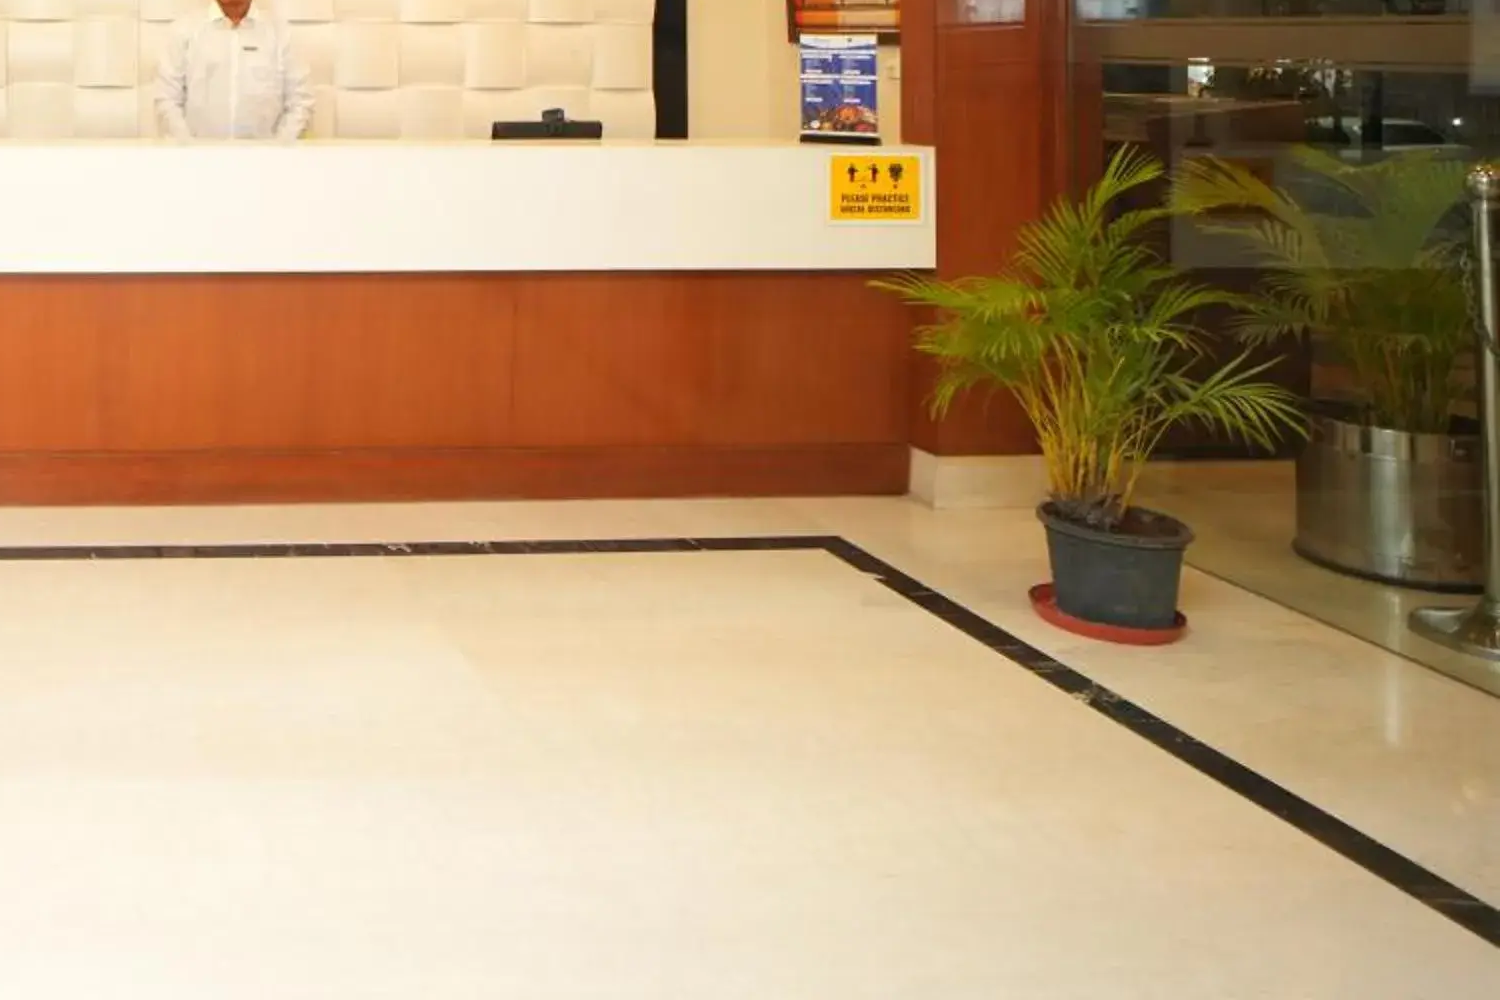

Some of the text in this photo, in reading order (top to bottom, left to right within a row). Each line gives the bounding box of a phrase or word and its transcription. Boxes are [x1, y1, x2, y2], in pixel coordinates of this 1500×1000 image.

[841, 193, 909, 203] PLEASE PRACTICE
[840, 204, 911, 213] SOCIAL DISTANCING
